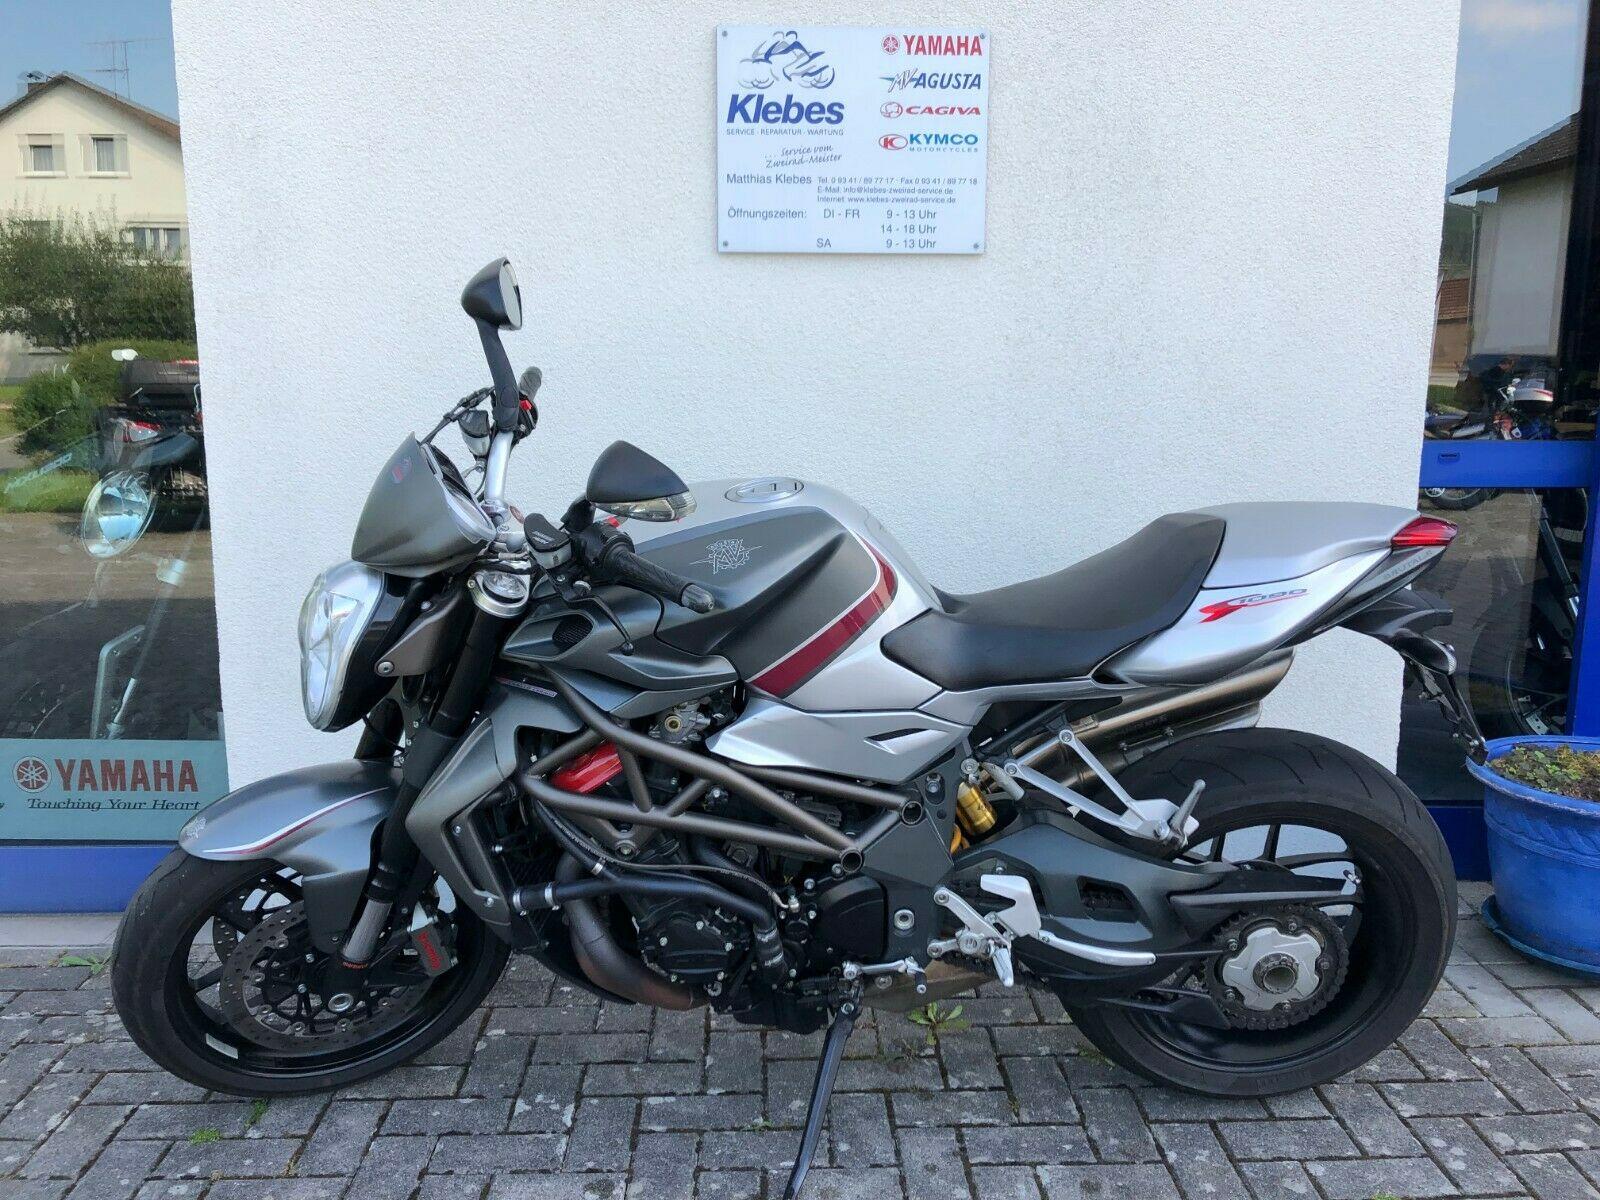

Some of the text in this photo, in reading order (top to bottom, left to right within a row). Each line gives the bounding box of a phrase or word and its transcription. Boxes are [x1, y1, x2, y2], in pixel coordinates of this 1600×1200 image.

[903, 34, 983, 56] YAMAHA
[913, 72, 982, 90] AGUSTA
[727, 93, 845, 125] Klebes
[905, 105, 981, 116] CAGIVA
[726, 128, 844, 136] SERVICE REPARATUR WARTUNG
[909, 133, 979, 145] KYMCO
[726, 173, 812, 184] Matthias Klebes
[727, 205, 807, 220] Öffnungszeiten:
[823, 208, 835, 218] DI
[845, 208, 860, 218] FR
[886, 209, 893, 219] 9
[904, 209, 916, 219] 13
[918, 209, 937, 219] Uhr
[881, 224, 893, 234] 14
[904, 224, 916, 234] 18
[918, 224, 937, 234] Uhr
[816, 238, 832, 248] SA
[886, 239, 893, 248] 9
[903, 239, 915, 248] 13
[918, 239, 937, 248] Uhr
[54, 758, 199, 792] YAMAHA
[27, 798, 201, 812] Touching Your Heart
